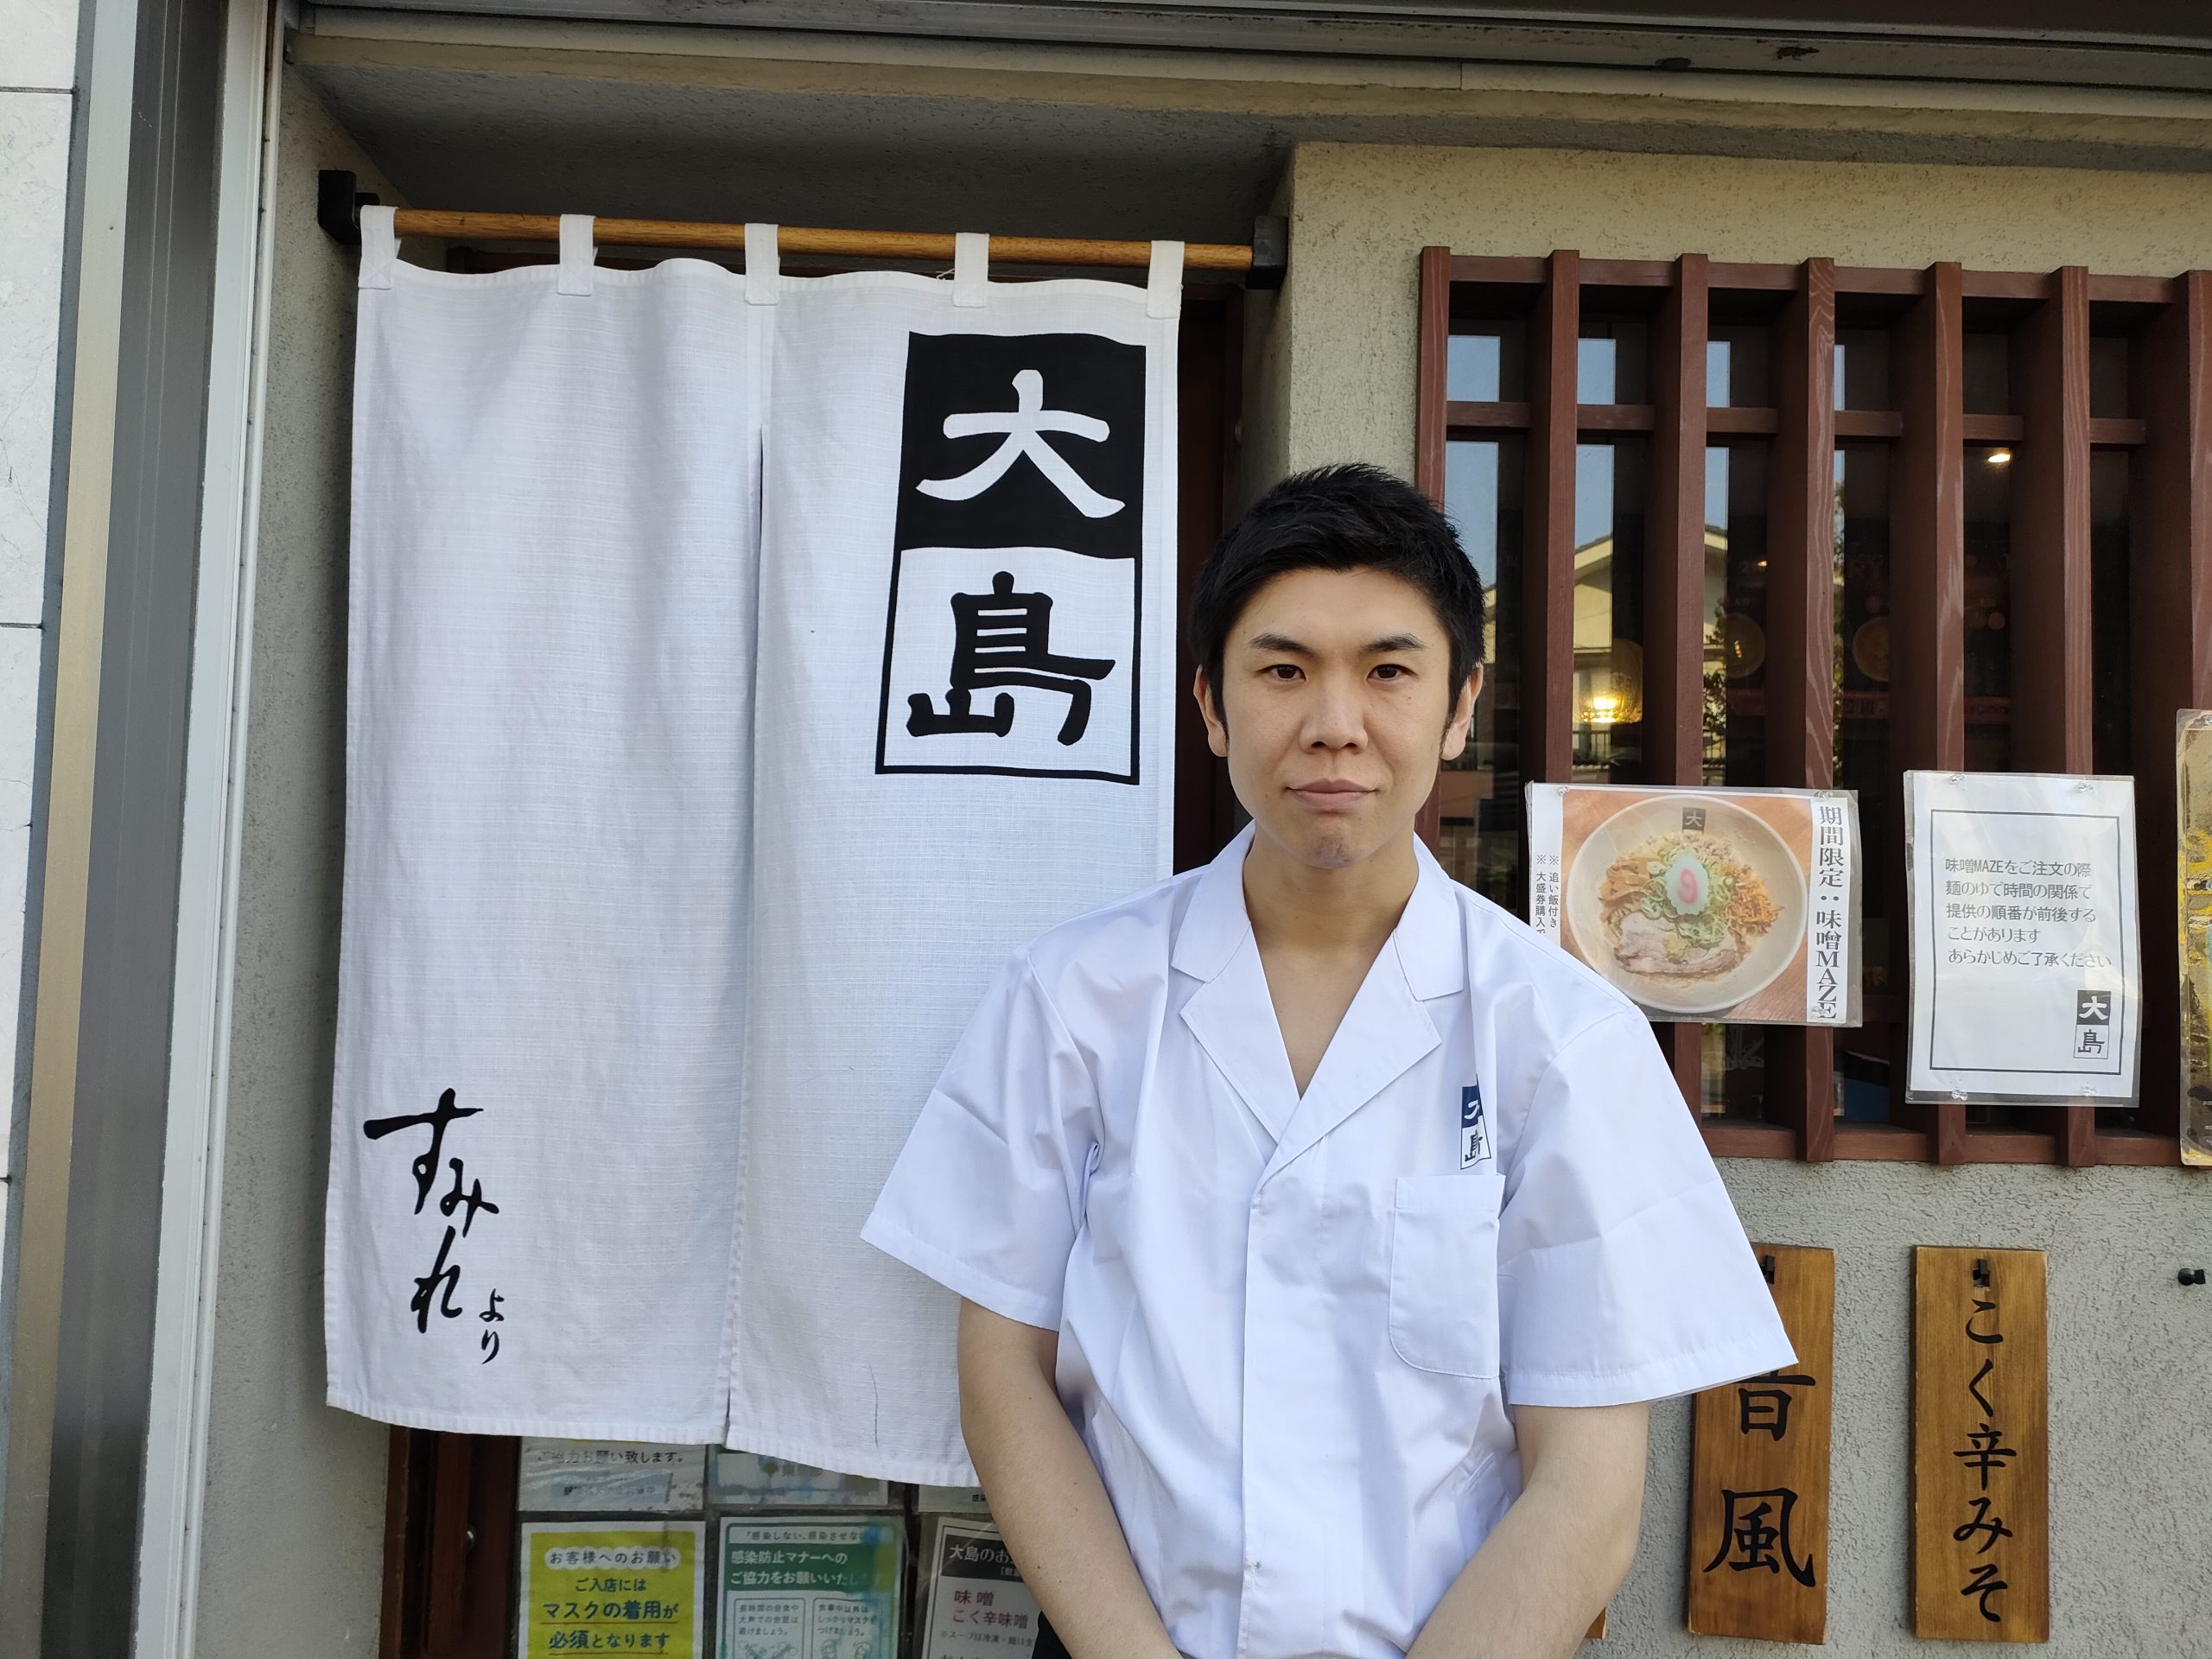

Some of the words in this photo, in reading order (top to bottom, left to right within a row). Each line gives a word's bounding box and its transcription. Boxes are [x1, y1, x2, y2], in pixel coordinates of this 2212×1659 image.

[906, 369, 1127, 747] 大島
[1684, 811, 1704, 828] 大
[1945, 858, 2092, 878] 味噌MAZEをご注文の際
[1945, 880, 2092, 900] 麺のゆで時間の関係で
[1946, 903, 2097, 923] 提供の順番が前後する
[1947, 925, 2042, 944] ことがあります
[1948, 948, 2113, 968] あらかじめご了承ください
[2076, 995, 2110, 1055] 大島
[363, 1088, 499, 1333] すみれ
[479, 1288, 505, 1364] より
[1953, 1299, 2017, 1622] こく辛みそ
[549, 1549, 677, 1565] お客様へのお願い
[731, 1549, 849, 1565] 感染防止マナーへの
[948, 1543, 1014, 1564] 大島のお
[575, 1577, 646, 1592] ご入店には
[543, 1599, 679, 1620] マスクの着用が
[953, 1610, 1028, 1630] こく辛味噌
[549, 1630, 671, 1650] 必須となります
